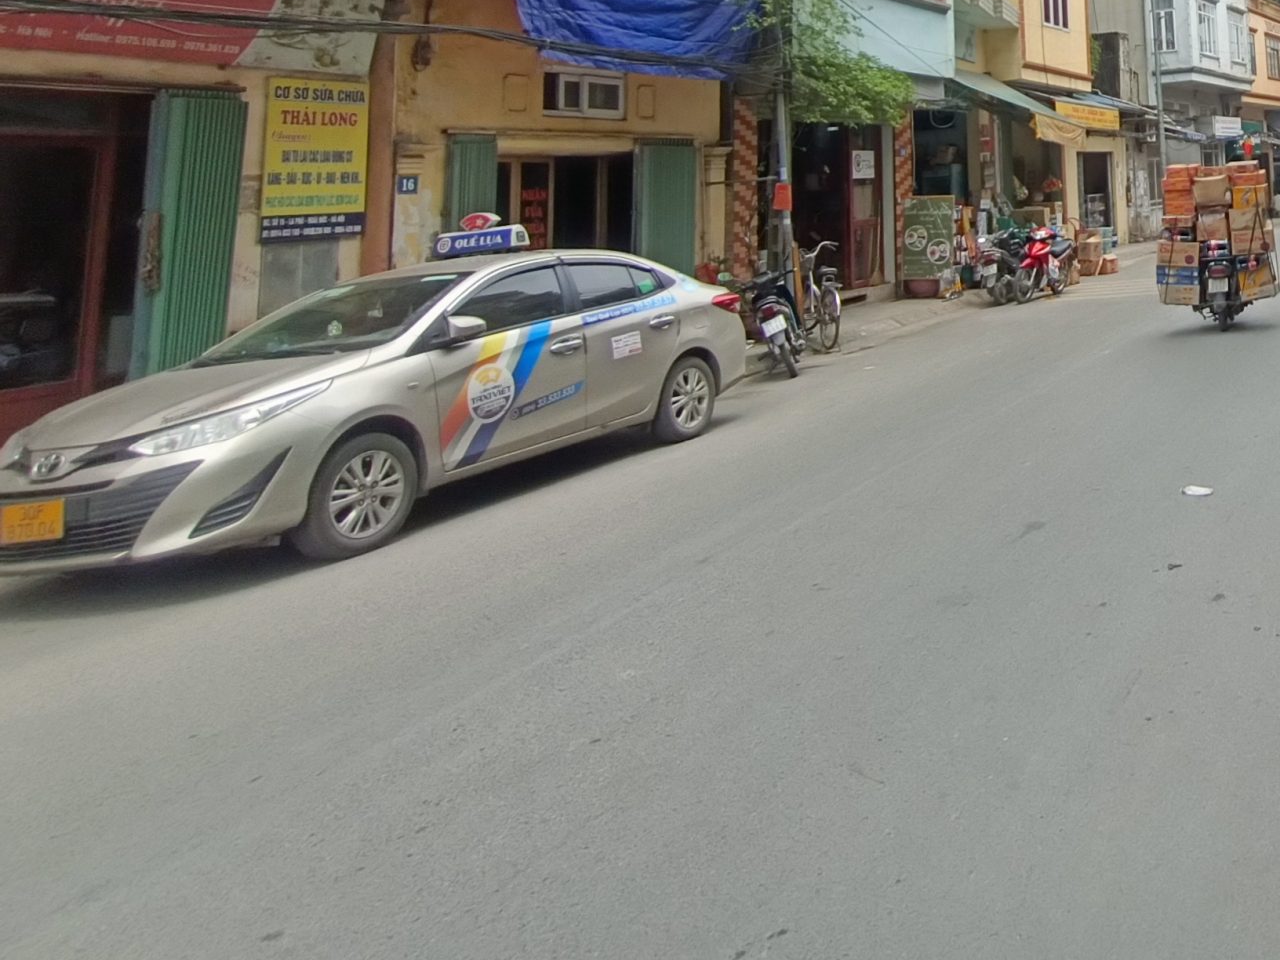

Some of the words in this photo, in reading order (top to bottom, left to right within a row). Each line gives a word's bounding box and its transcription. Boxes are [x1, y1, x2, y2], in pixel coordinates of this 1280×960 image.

[274, 85, 291, 99] CƠ
[293, 81, 310, 100] SỞ
[312, 84, 334, 101] SỬA
[320, 110, 358, 127] LONG
[402, 178, 415, 191] 16
